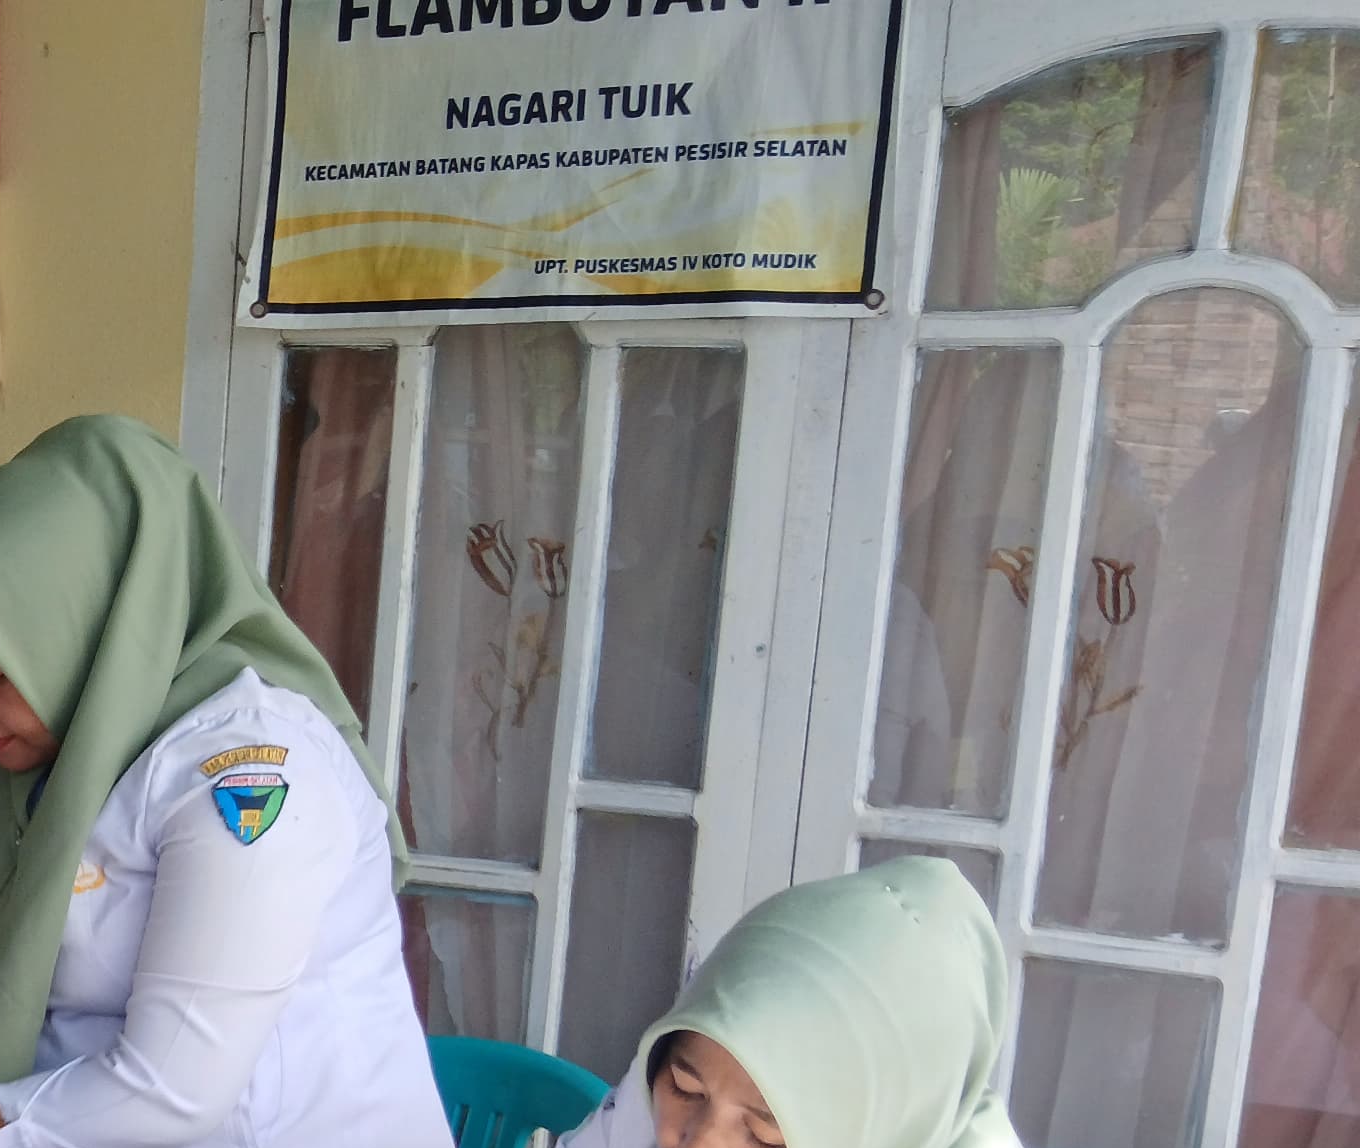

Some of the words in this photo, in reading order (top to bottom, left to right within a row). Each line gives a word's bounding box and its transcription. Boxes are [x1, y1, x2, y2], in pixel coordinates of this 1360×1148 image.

[446, 89, 586, 129] NAGARI
[598, 82, 693, 119] TUIK
[305, 161, 410, 181] KECAMATAN
[415, 156, 485, 175] BATANG
[490, 152, 550, 171] KAPAS
[556, 147, 668, 168] KABUPATEN
[675, 141, 748, 162] PESISIR
[753, 139, 847, 157] SELATAN
[534, 259, 568, 274] UPT.
[574, 256, 677, 274] PUSKESMAS
[682, 255, 698, 271] IV
[702, 253, 746, 269] KOTO
[751, 253, 817, 269] MUDIK
